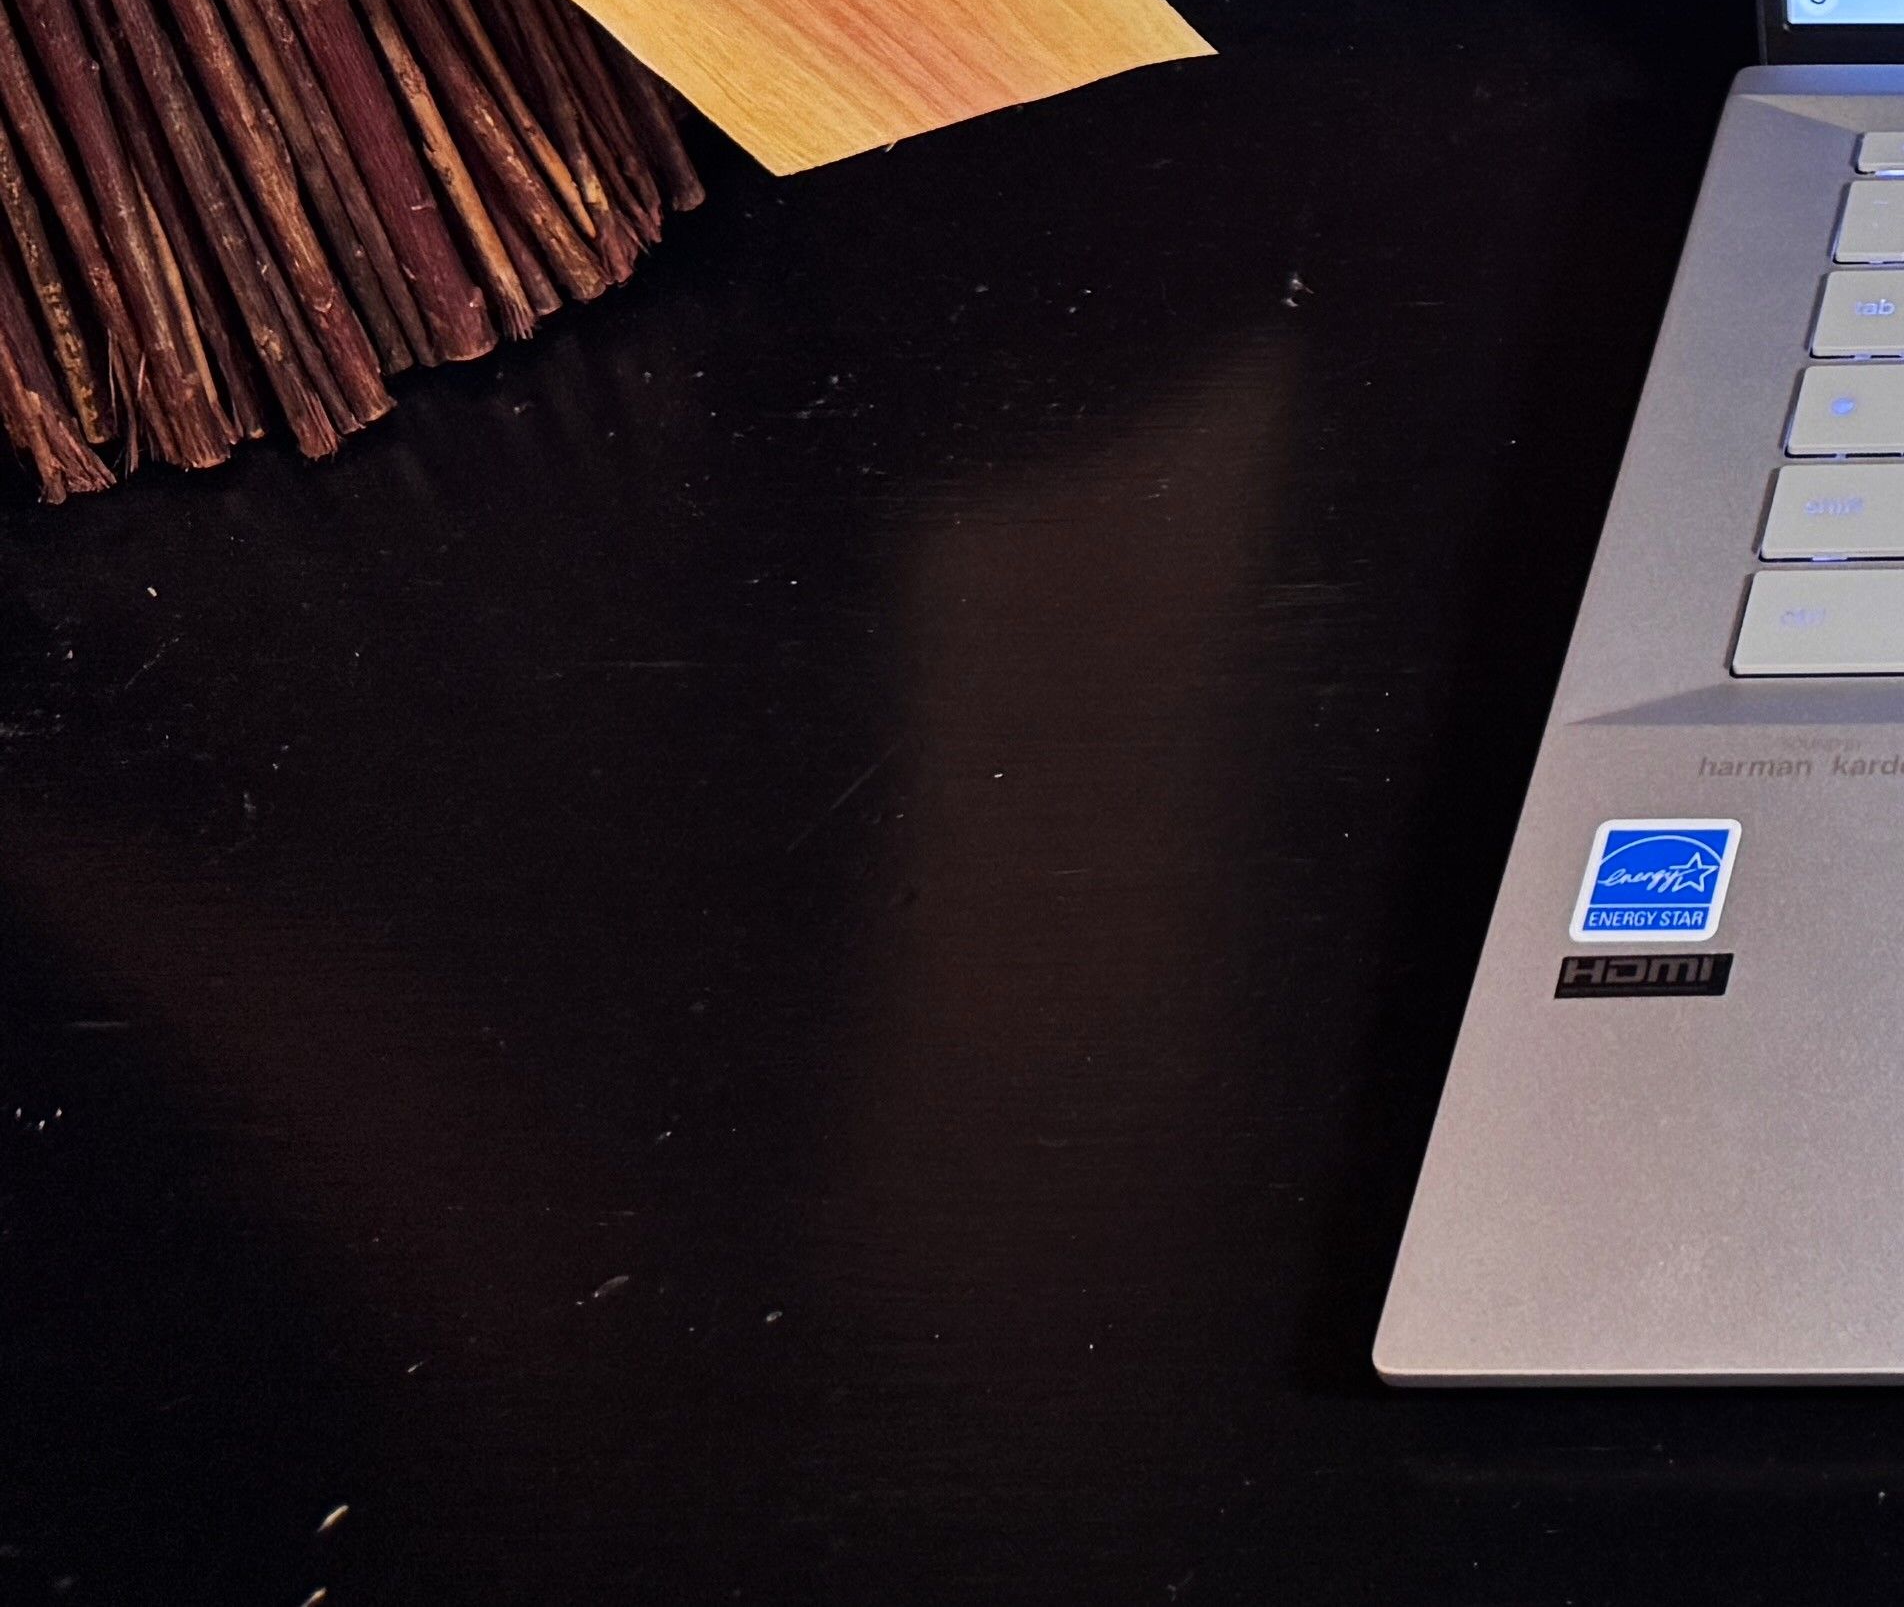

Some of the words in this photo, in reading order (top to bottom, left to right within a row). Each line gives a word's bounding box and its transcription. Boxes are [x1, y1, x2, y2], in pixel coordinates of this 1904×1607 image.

[1854, 298, 1896, 316] tab
[1700, 754, 1813, 778] harman
[1589, 910, 1656, 928] ENERGY
[1660, 909, 1705, 927] STAR
